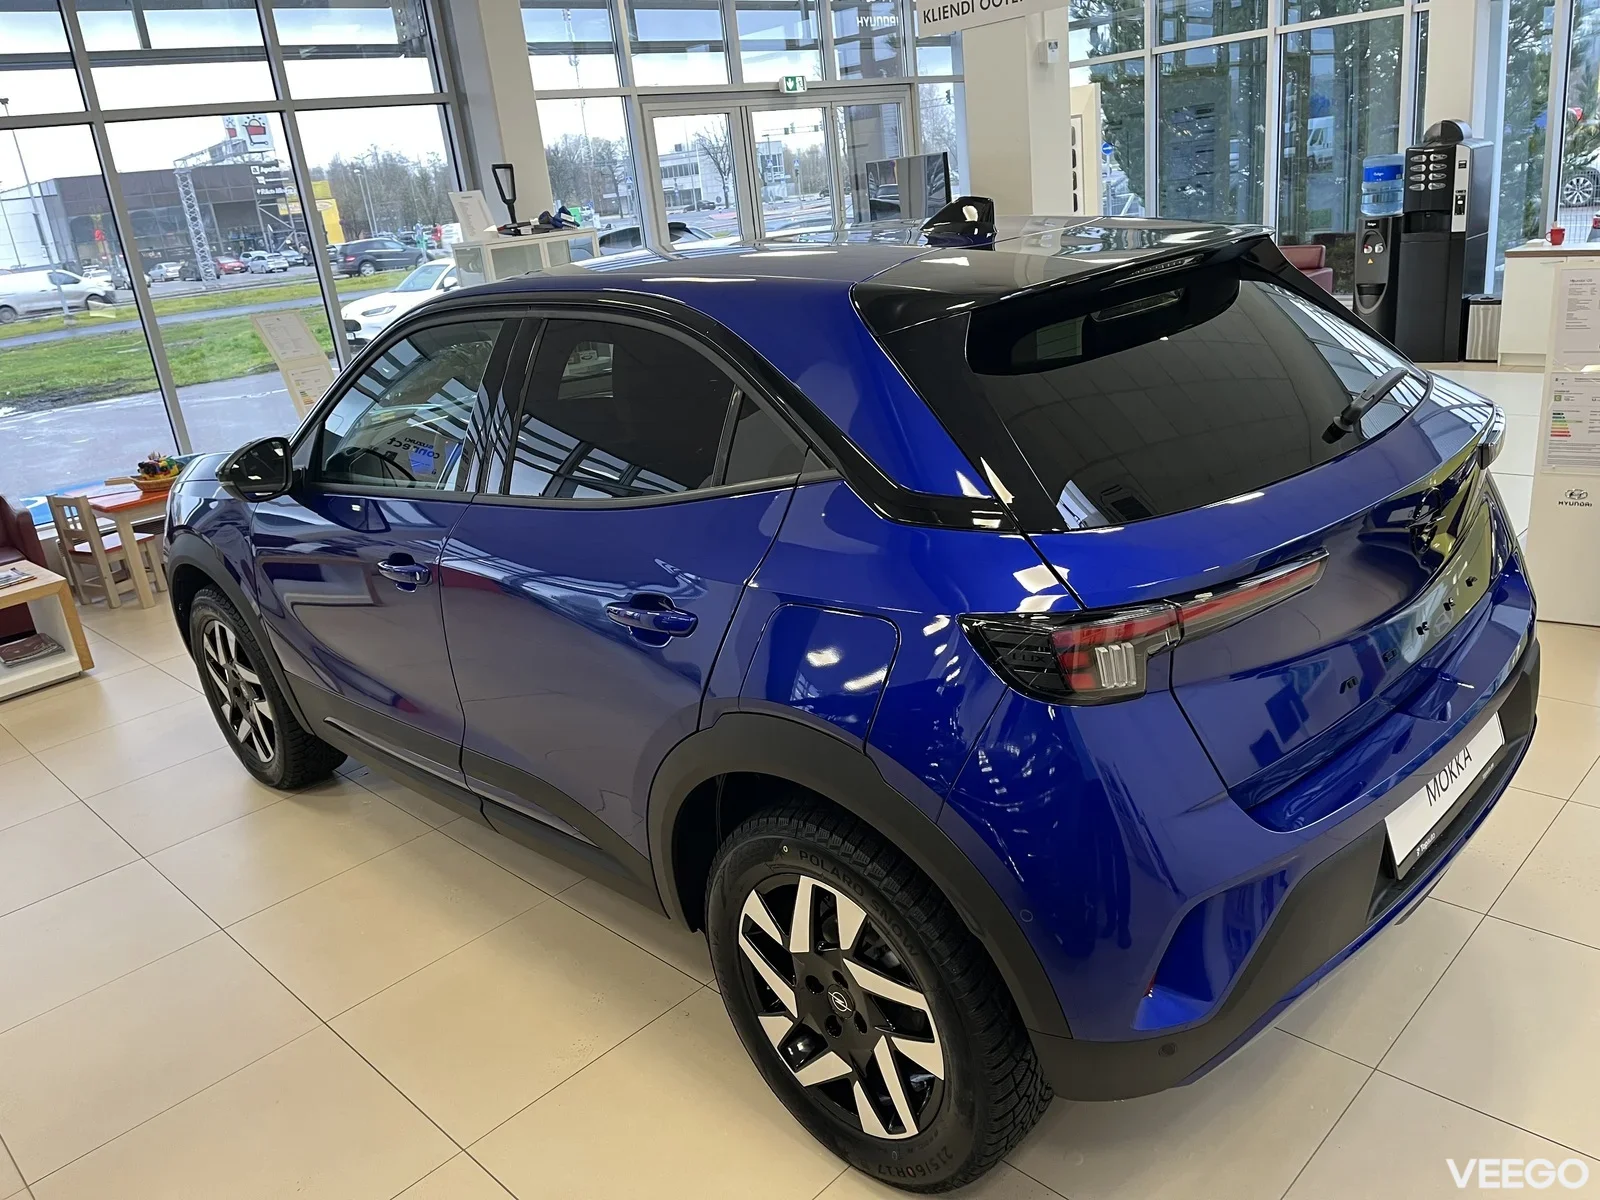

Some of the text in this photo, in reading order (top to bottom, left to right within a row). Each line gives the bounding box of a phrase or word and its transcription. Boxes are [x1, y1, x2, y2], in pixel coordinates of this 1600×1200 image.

[856, 16, 899, 27] HYUNDAI
[923, 0, 975, 24] KLIENDI
[1558, 500, 1593, 508] HYUNDAI
[1425, 746, 1473, 807] MOKKA
[799, 849, 920, 957] POLARO SNOW
[878, 1145, 955, 1179] 215/60R17
